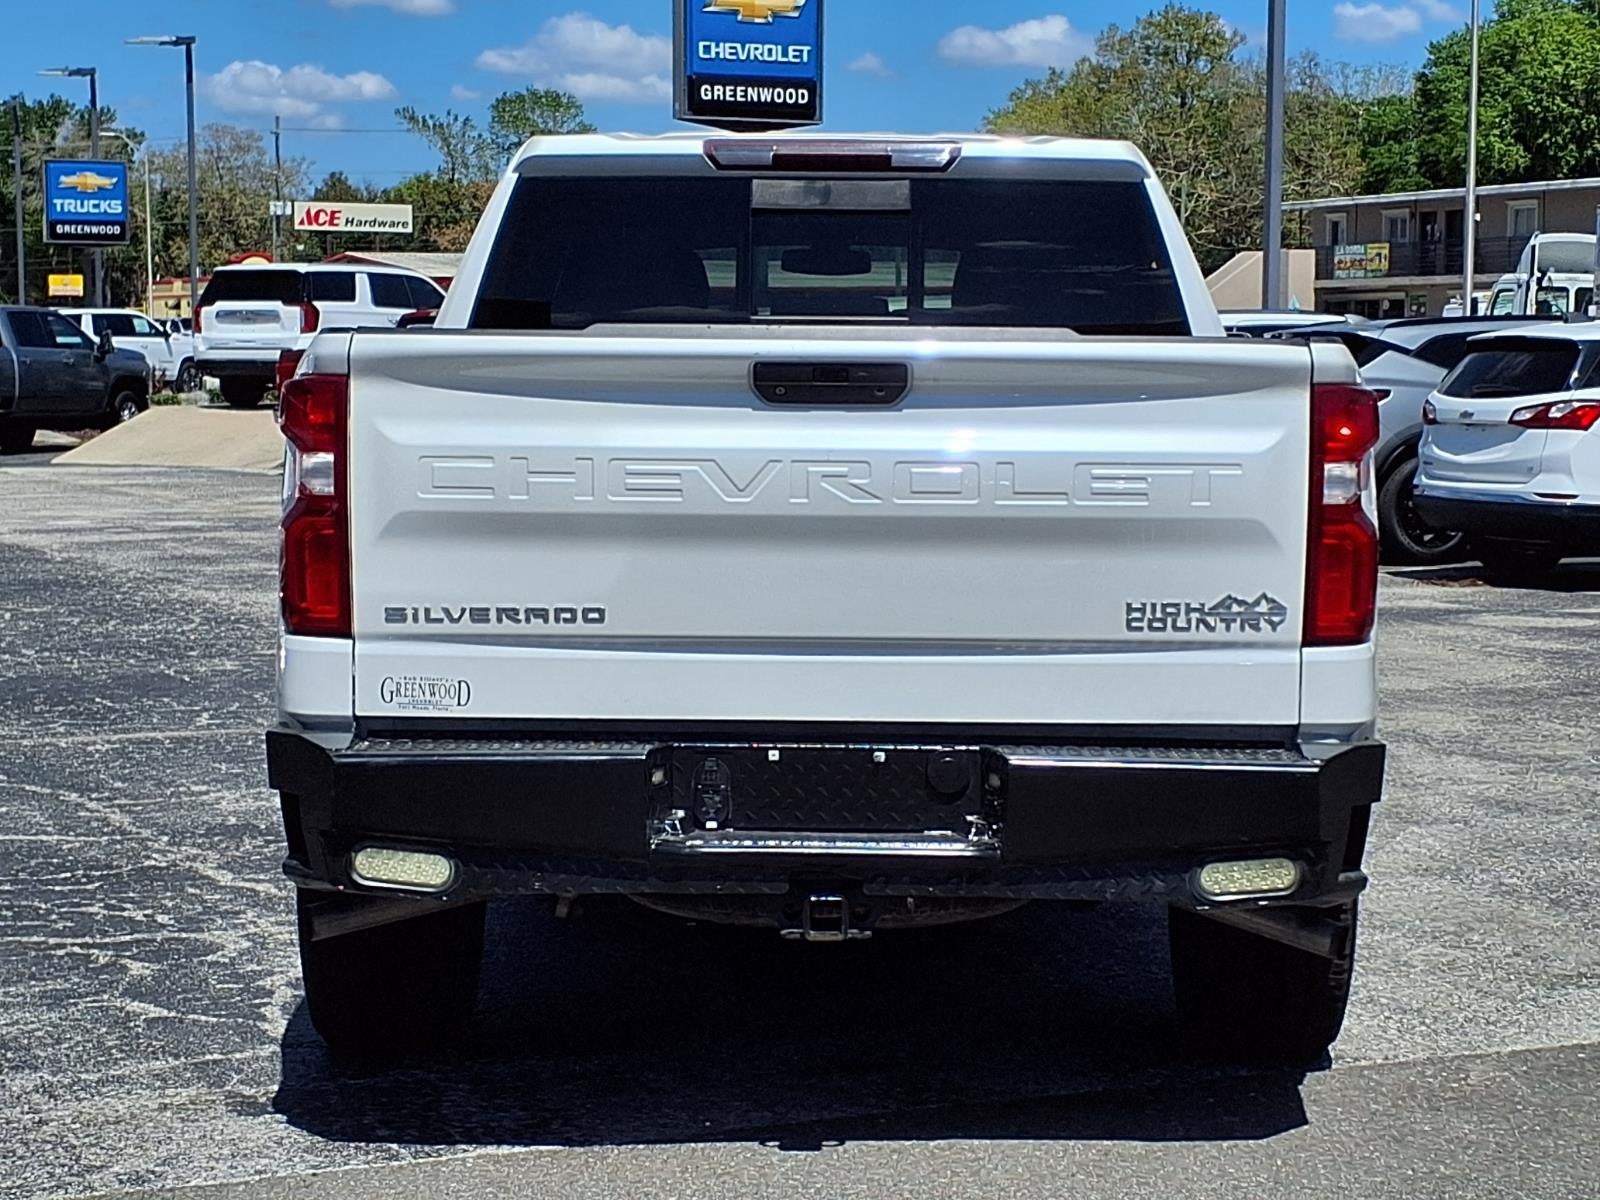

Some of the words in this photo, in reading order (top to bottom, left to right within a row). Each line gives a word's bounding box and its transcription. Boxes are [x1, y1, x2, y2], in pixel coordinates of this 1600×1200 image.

[698, 41, 812, 63] CHEVROLET
[700, 84, 809, 104] GREENWOOD
[53, 198, 123, 214] TRUCKS
[298, 206, 343, 227] ACE
[344, 217, 409, 229] Hardware
[56, 223, 121, 235] GREENWOOD
[417, 455, 1243, 506] CHEVROLET
[384, 606, 607, 625] SILVERADO
[1126, 601, 1206, 618] HIGH
[1126, 616, 1287, 633] COUNTRY
